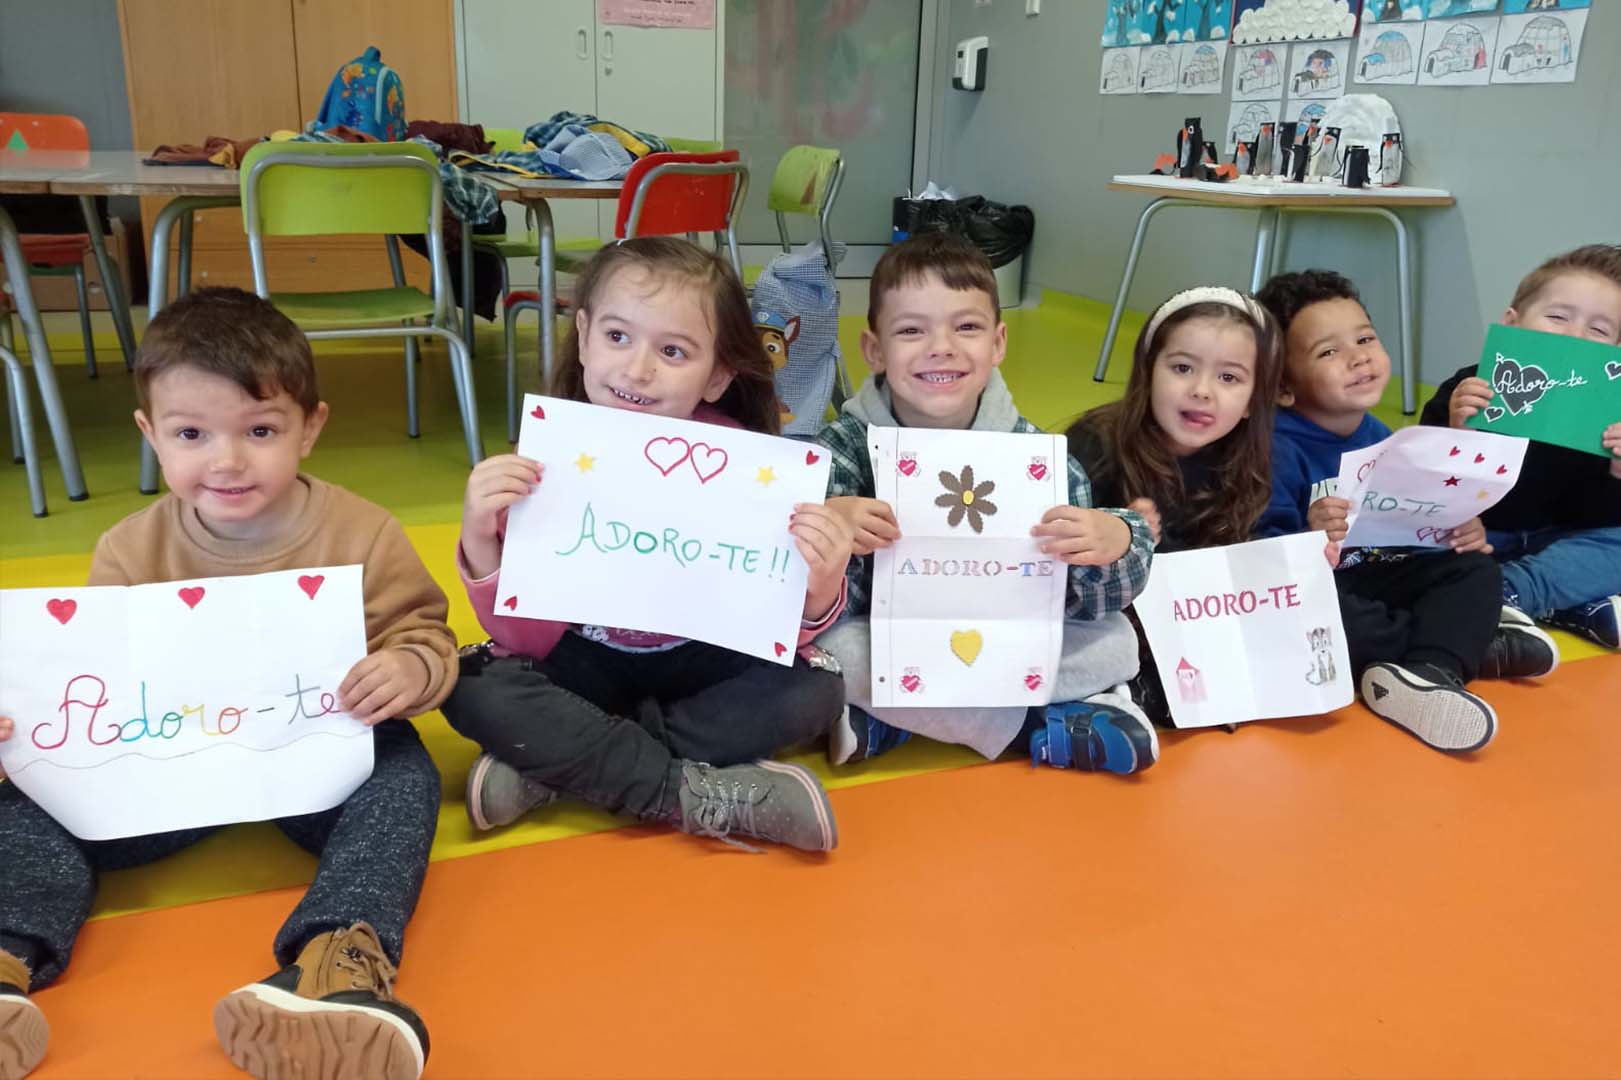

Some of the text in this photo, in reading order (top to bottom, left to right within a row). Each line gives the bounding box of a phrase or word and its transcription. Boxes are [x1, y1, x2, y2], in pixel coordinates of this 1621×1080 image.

[1494, 369, 1587, 393] Adoro-te
[898, 558, 1054, 576] ADORO-TE
[1173, 584, 1301, 621] ADORO-TE
[32, 673, 341, 750] Adoro-te
